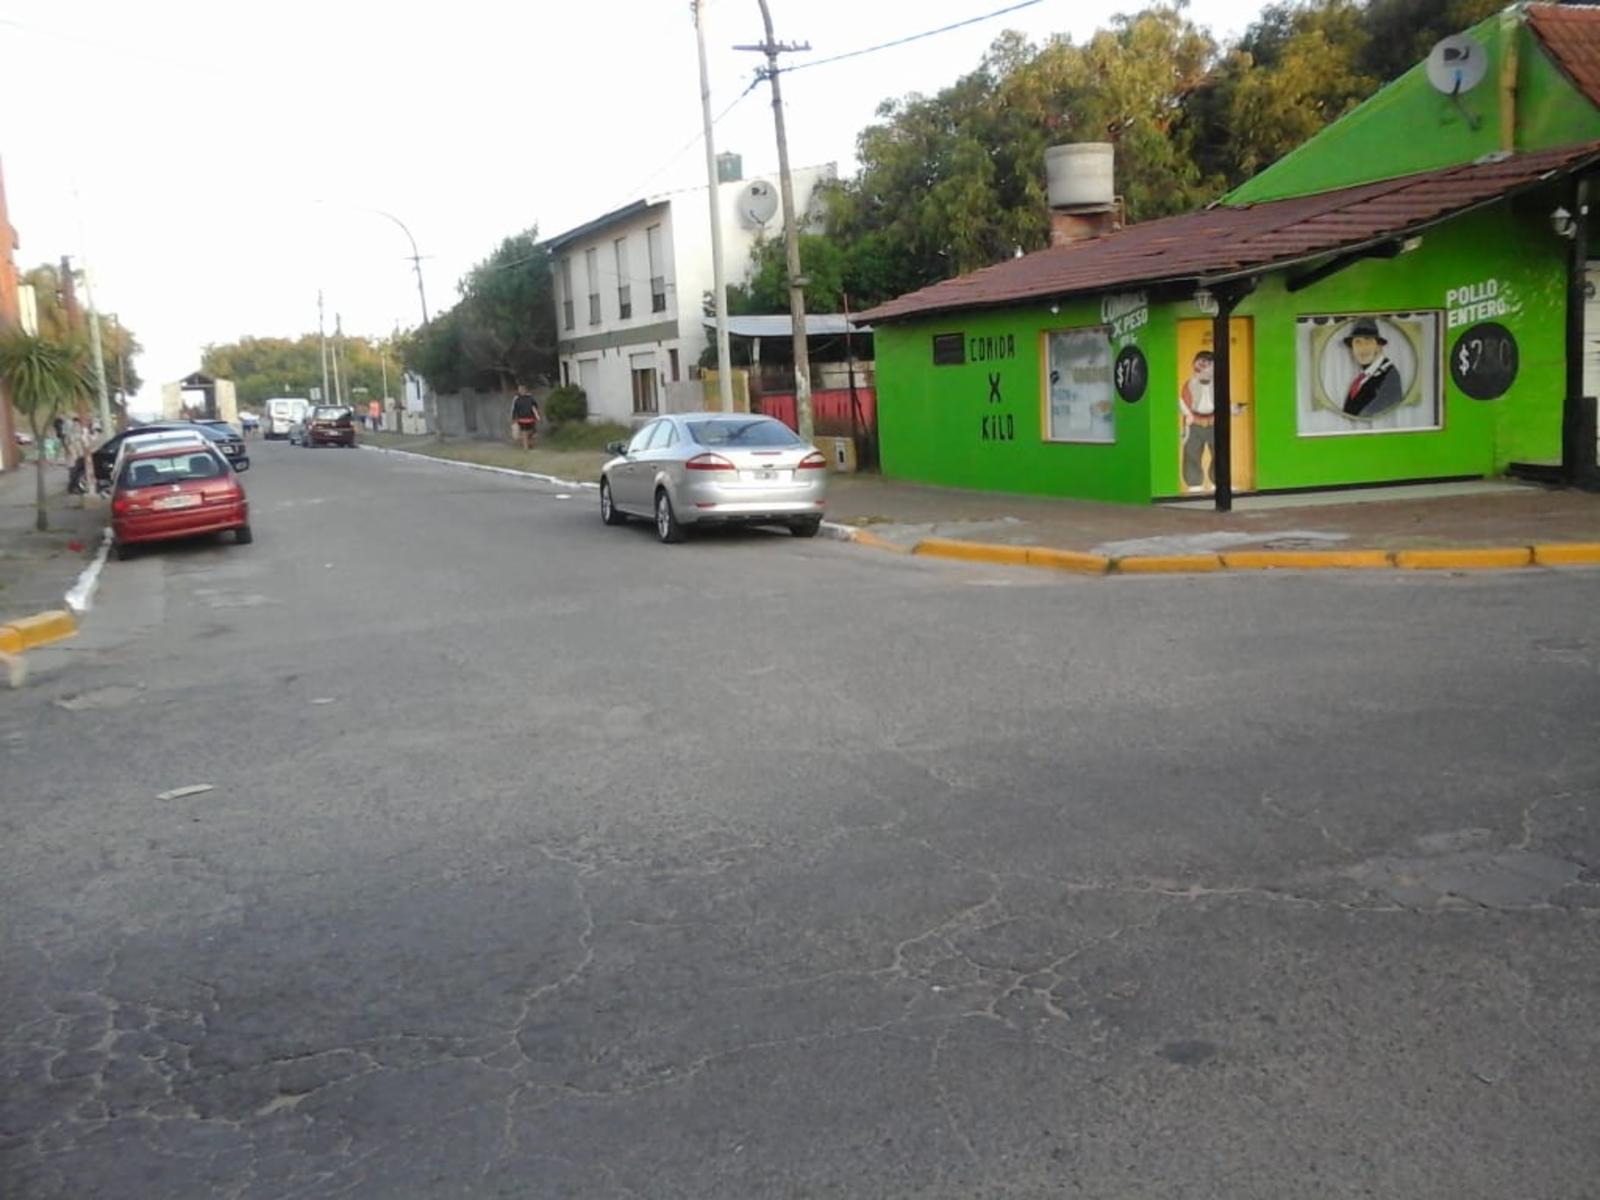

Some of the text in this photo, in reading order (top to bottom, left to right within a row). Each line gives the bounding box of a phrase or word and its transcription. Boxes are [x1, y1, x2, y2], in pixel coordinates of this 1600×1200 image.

[1446, 279, 1498, 309] POLLO
[1448, 298, 1506, 329] ENTERO
[970, 333, 1015, 361] COMIDA
[988, 372, 1001, 404] X
